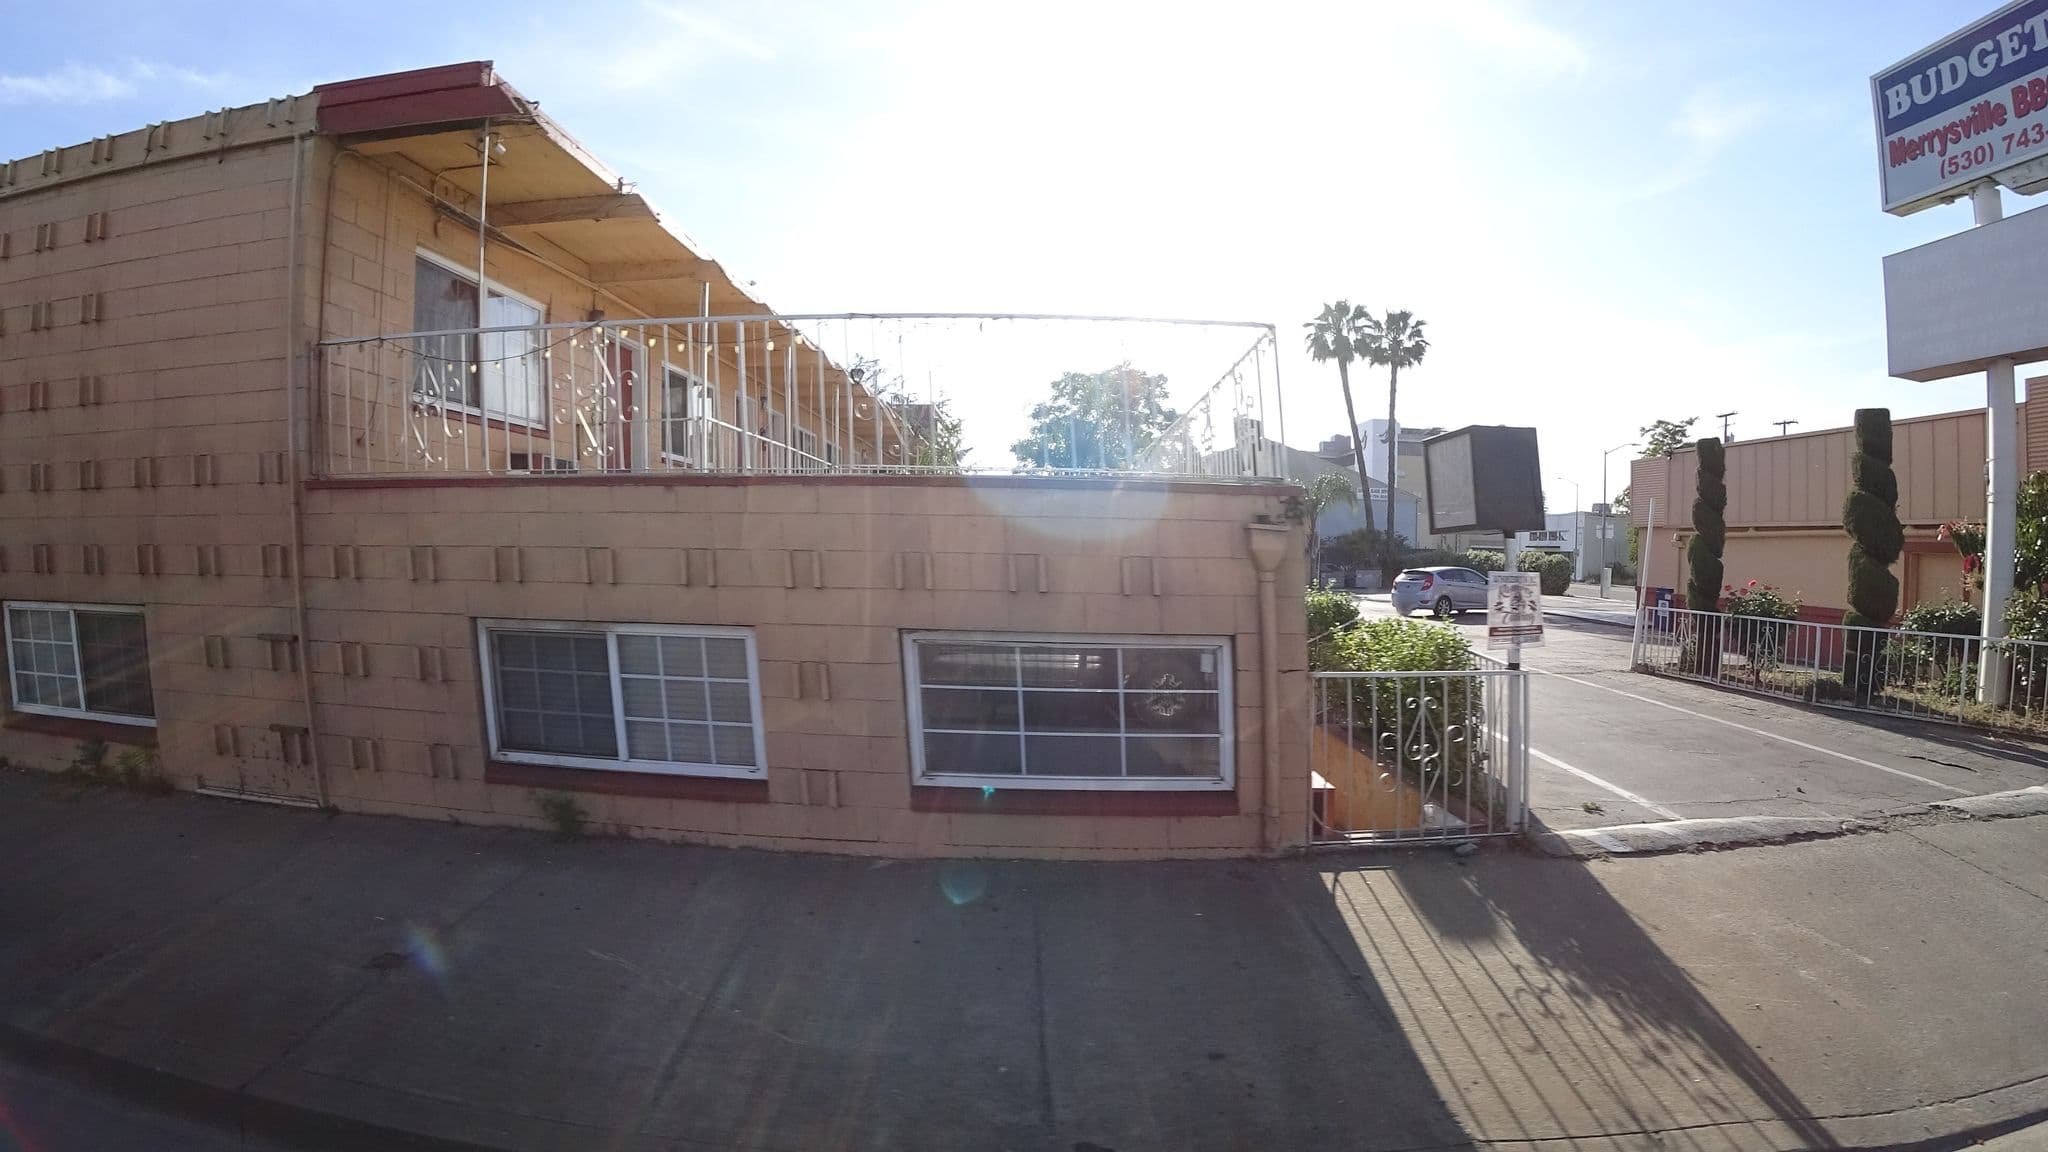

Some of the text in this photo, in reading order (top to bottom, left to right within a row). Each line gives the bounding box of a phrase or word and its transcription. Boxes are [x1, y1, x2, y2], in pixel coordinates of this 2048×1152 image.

[1885, 10, 2048, 119] BUDGET
[1889, 77, 2048, 168] Merrysville BB
[1940, 142, 1995, 179] (530)
